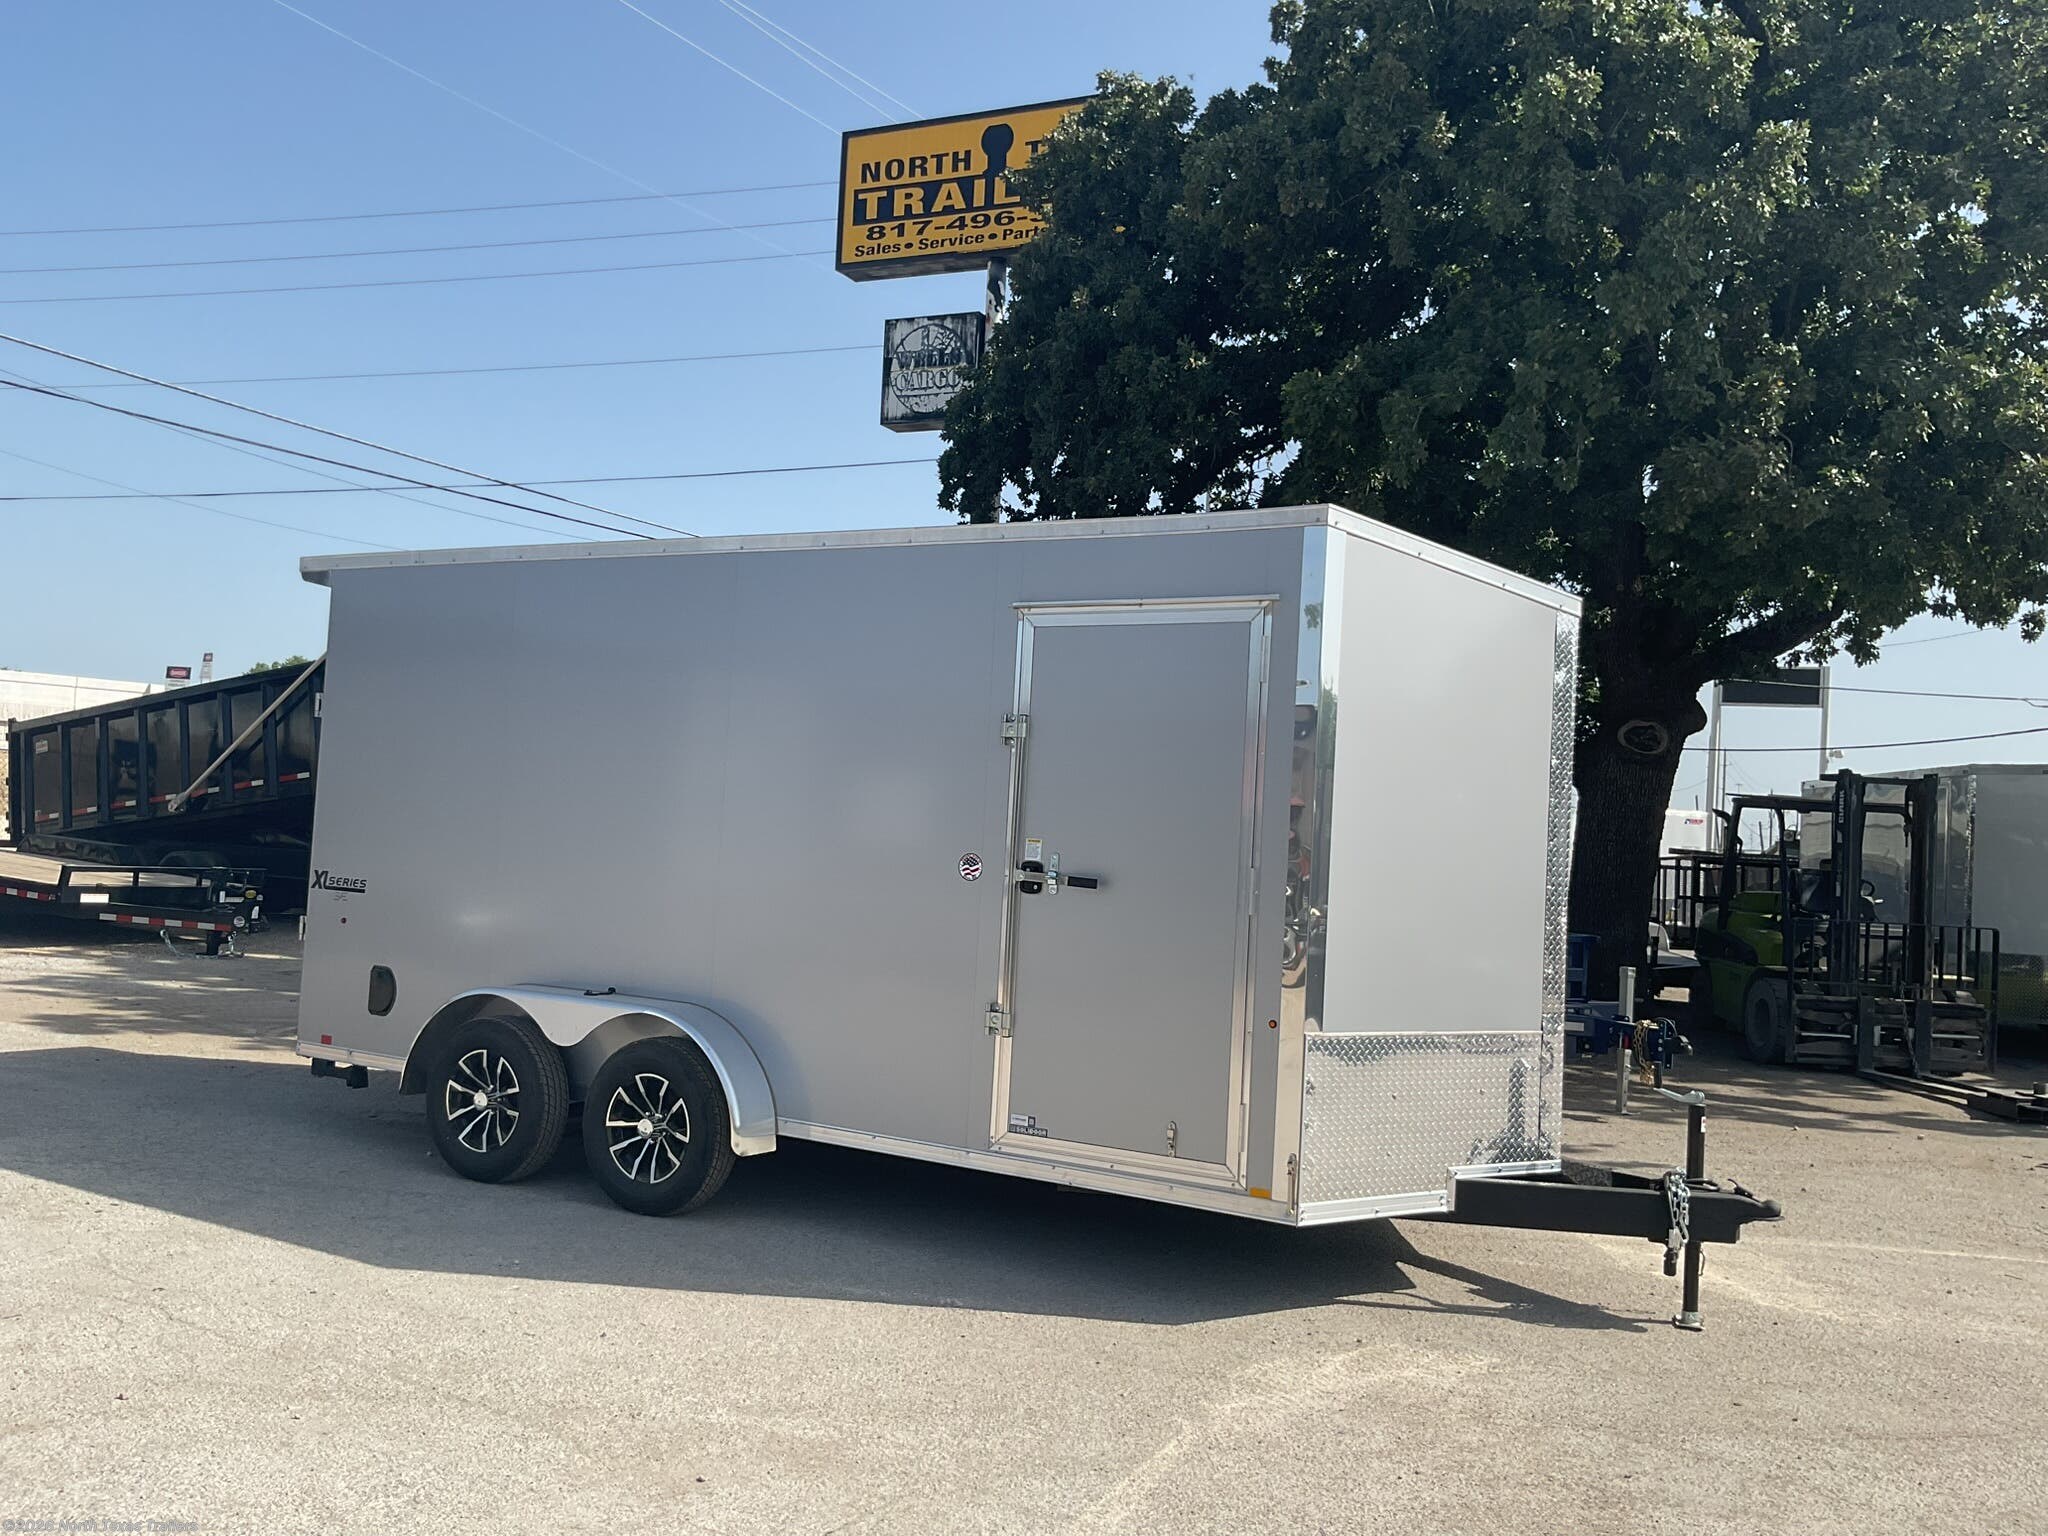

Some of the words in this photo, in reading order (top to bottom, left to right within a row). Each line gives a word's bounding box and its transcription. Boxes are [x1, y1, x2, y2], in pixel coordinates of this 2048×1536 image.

[861, 150, 971, 183] NORTH
[858, 177, 1020, 220] TRAIL
[865, 210, 1044, 240] 817-496-
[854, 242, 901, 258] Sales
[918, 231, 985, 251] Service
[896, 369, 961, 391] CARGO
[328, 876, 367, 889] SERIES
